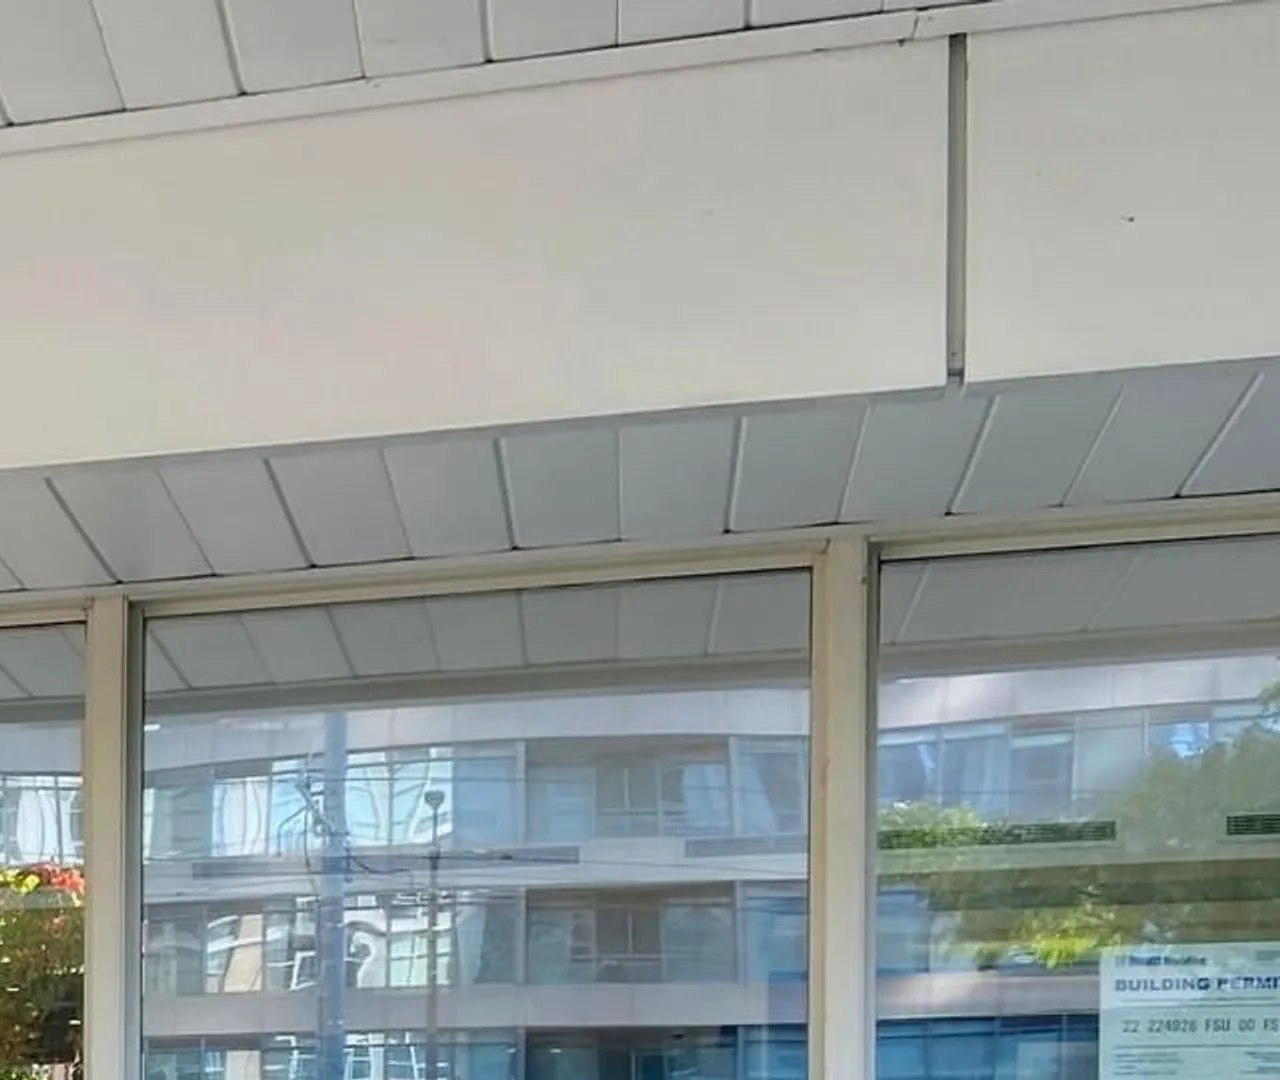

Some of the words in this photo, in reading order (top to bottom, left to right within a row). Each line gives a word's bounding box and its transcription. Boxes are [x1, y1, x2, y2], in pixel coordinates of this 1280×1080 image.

[1114, 977, 1211, 992] BUILDING
[1217, 976, 1280, 991] PERMI
[1122, 1019, 1140, 1033] 22
[1204, 1017, 1231, 1033] FSU
